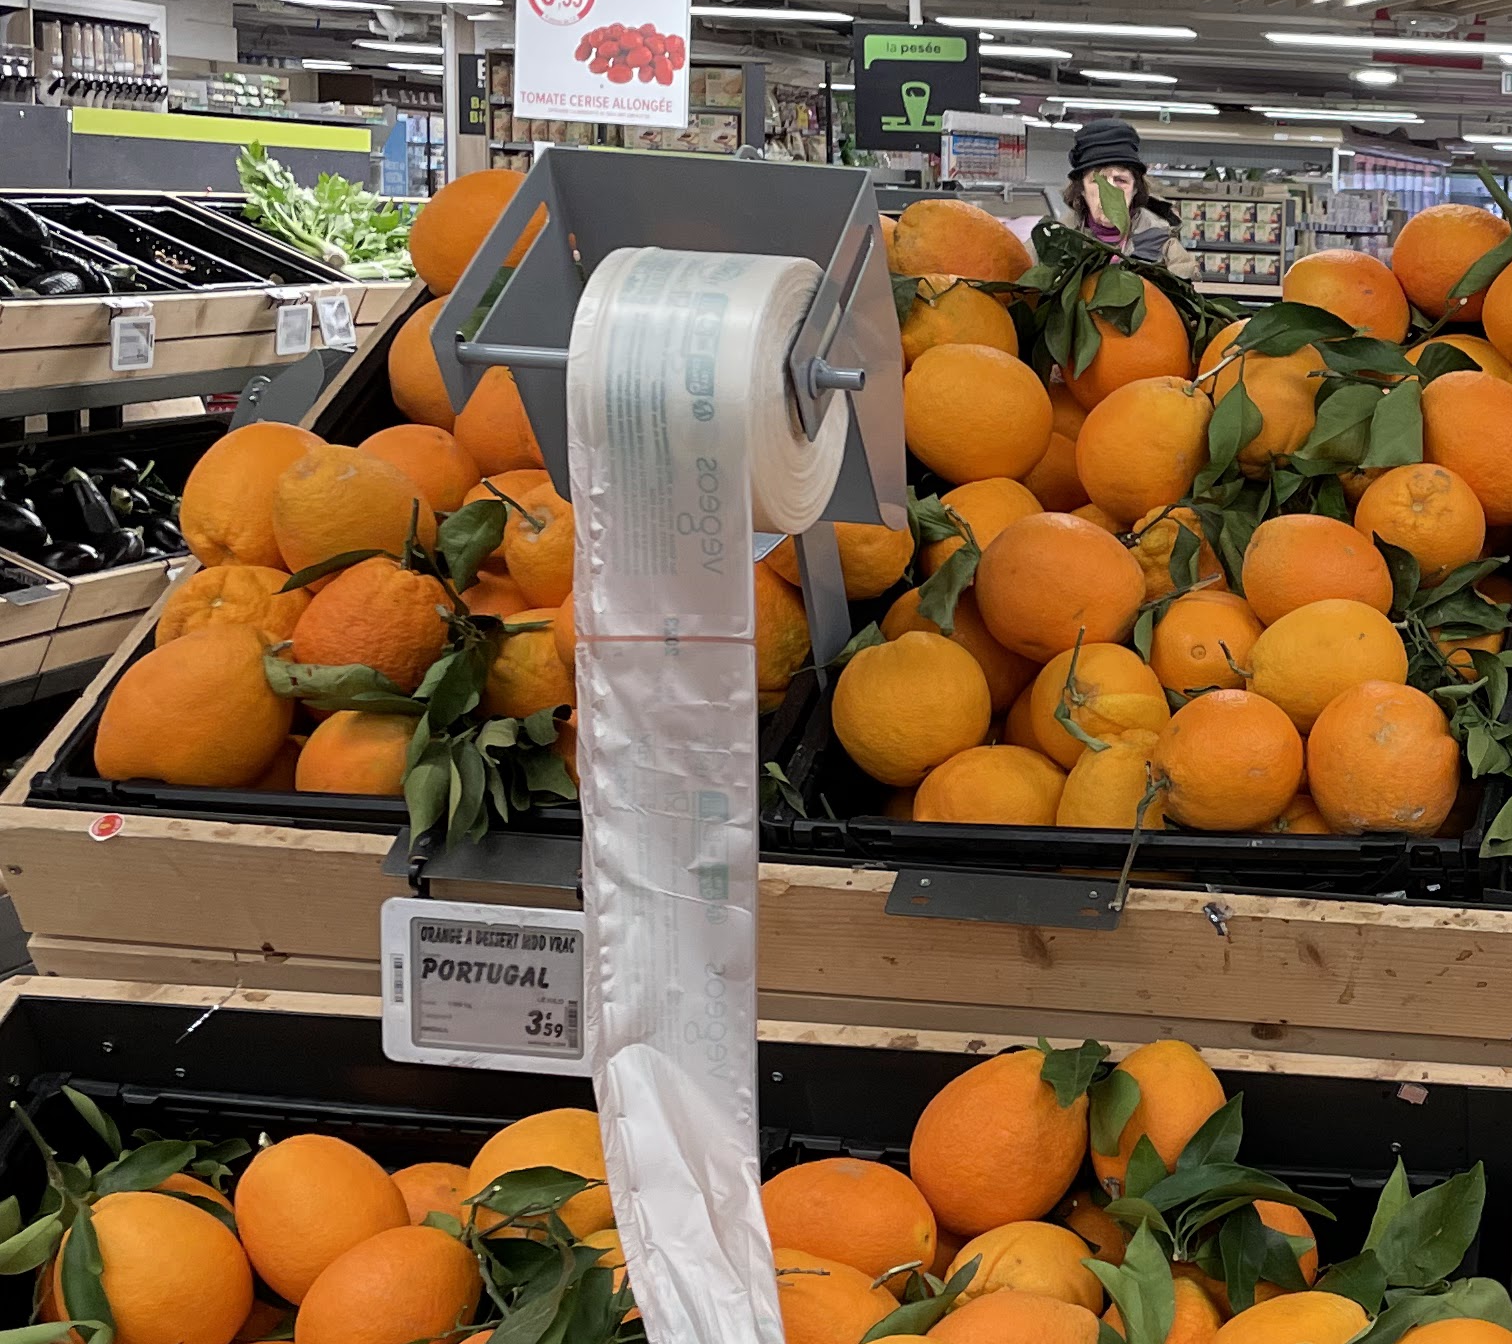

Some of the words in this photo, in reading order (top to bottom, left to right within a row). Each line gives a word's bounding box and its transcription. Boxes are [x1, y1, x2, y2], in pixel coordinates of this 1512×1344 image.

[886, 42, 897, 52] la
[900, 42, 941, 55] pesée
[520, 90, 567, 106] TOMATE
[569, 94, 609, 109] CERISE
[612, 97, 672, 113] ALLONGÉE
[421, 926, 463, 944] ORANGE
[549, 936, 576, 954] VRAC
[421, 957, 550, 989] PORTUGAL
